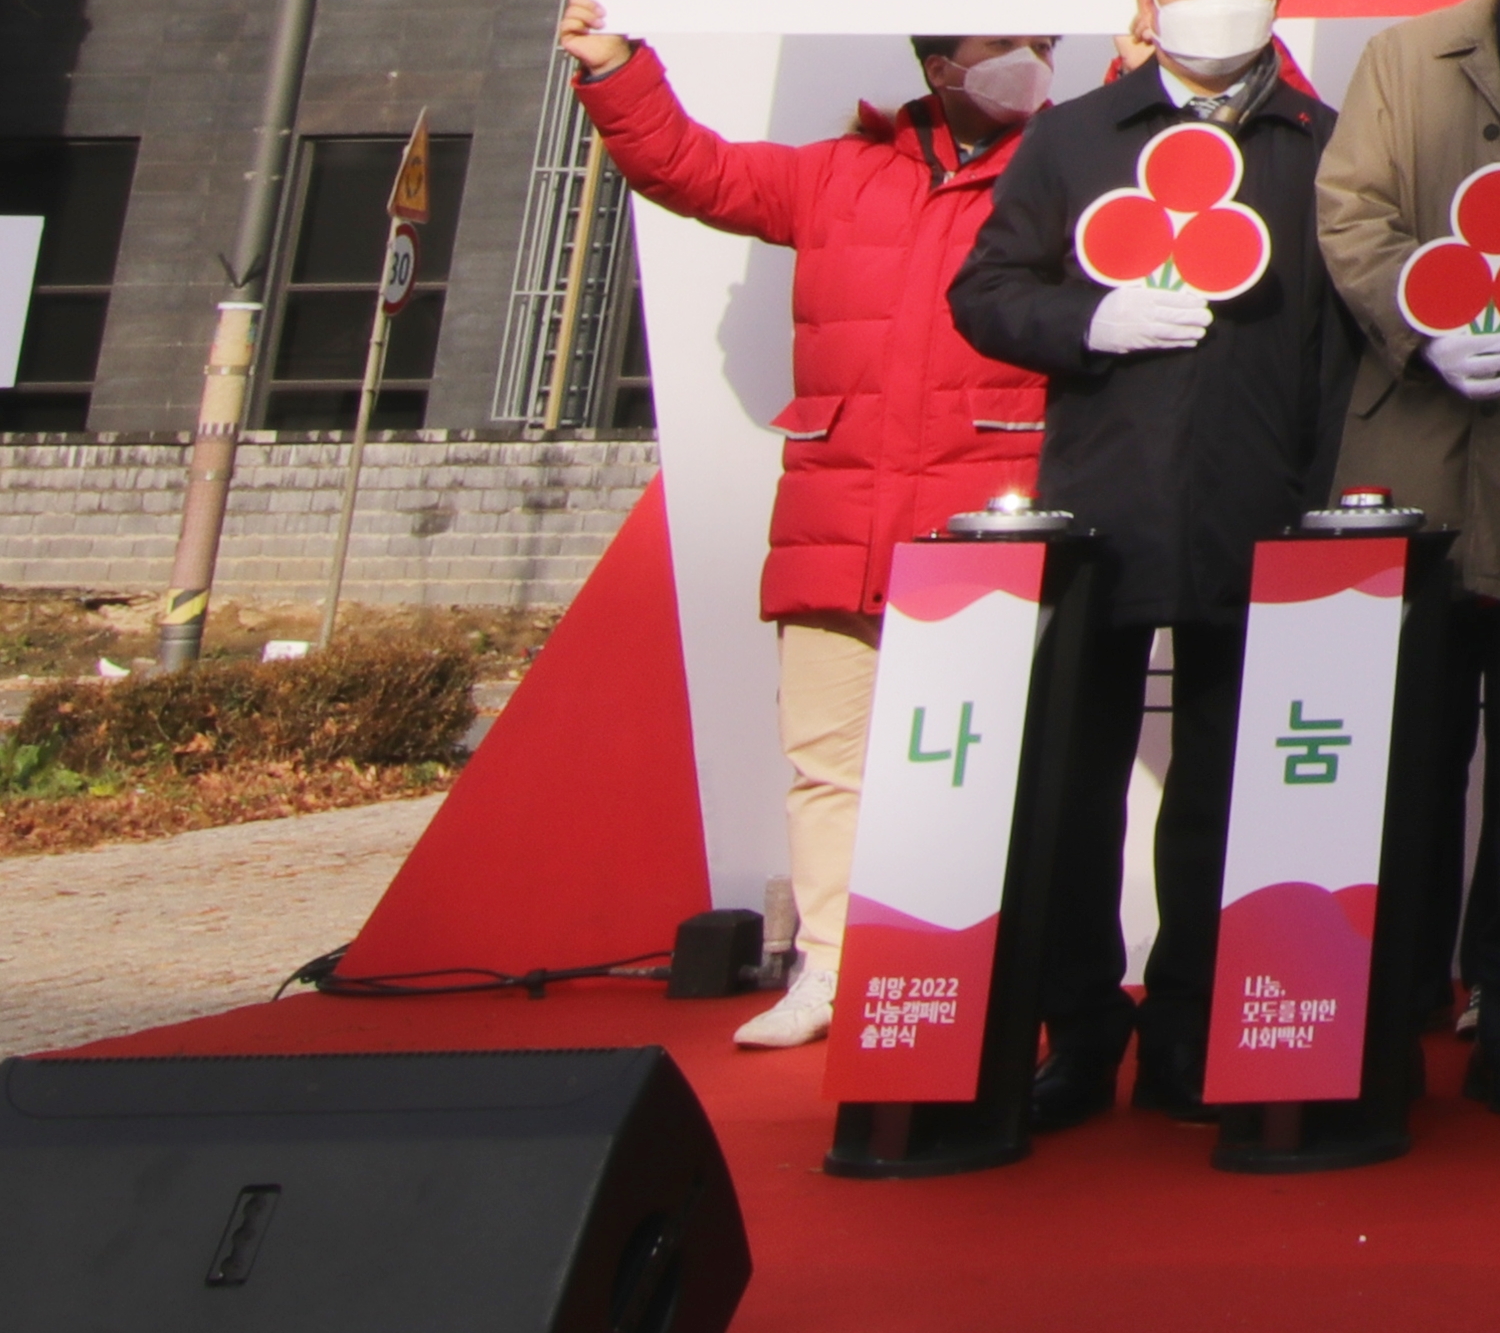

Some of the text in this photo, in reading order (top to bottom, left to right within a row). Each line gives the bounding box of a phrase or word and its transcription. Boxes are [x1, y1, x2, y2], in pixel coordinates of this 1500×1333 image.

[390, 252, 411, 286] 30
[908, 702, 980, 786] 나
[1275, 701, 1351, 785] 눔
[867, 977, 959, 998] 희망 2022
[864, 1001, 957, 1024] 나눔캠페인
[1241, 1000, 1336, 1023] 모두를 위한
[860, 1024, 916, 1049] 출범식
[1239, 1024, 1314, 1049] 사회백신
